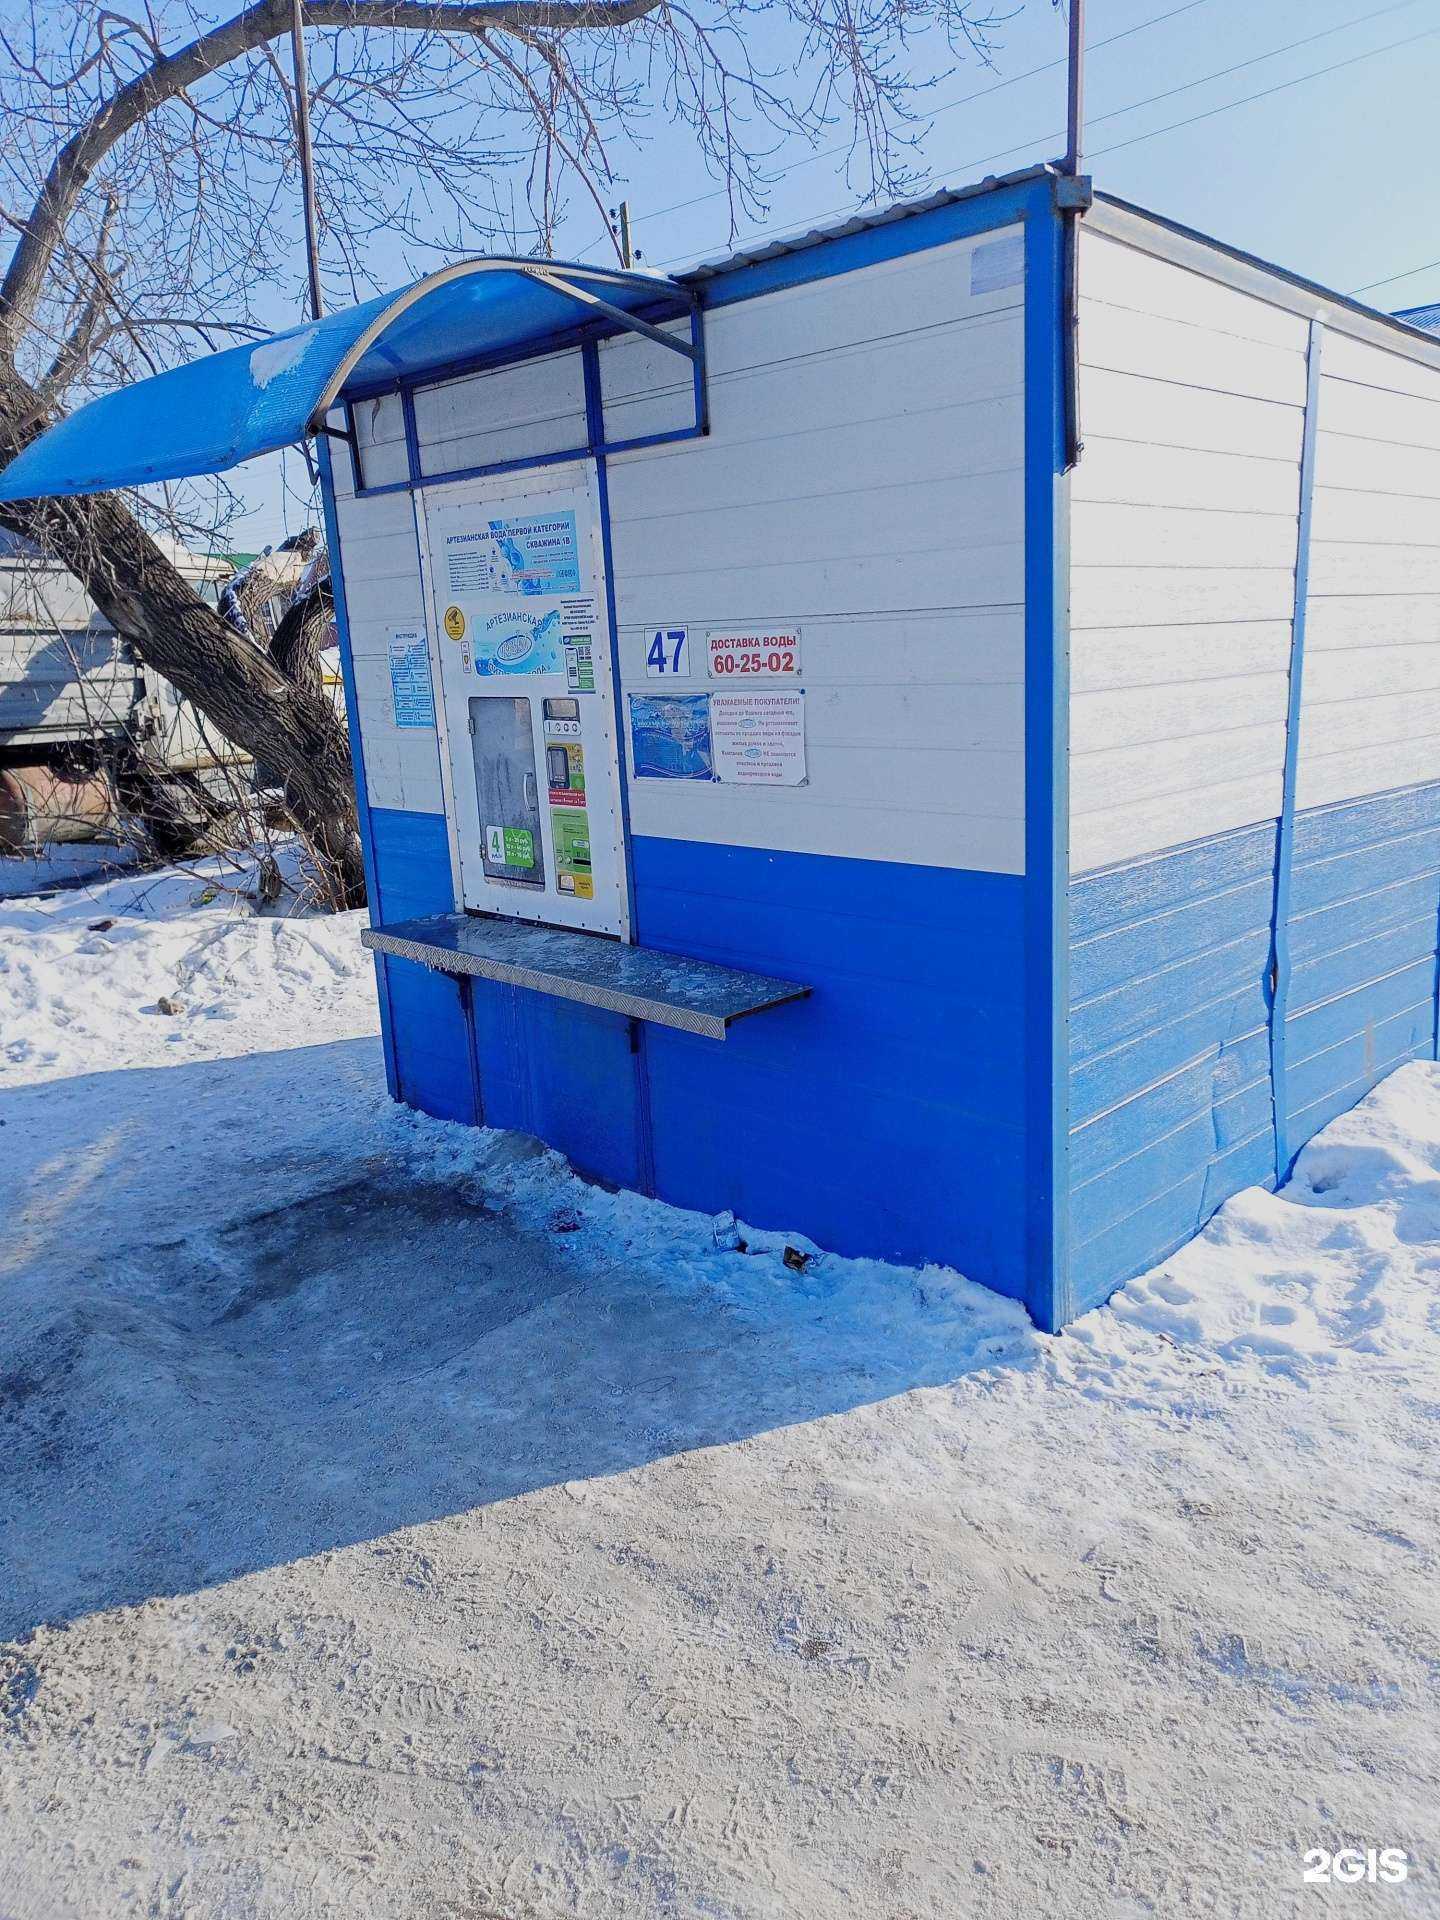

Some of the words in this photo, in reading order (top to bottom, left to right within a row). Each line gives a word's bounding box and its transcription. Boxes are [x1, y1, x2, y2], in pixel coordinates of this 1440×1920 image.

[446, 531, 489, 545] АРТЕЗИАНСКАЯ
[490, 529, 507, 539] ВОДА
[507, 525, 532, 537] ПЕРВОЙ
[533, 522, 570, 535] КАТЕГОРИИ
[526, 538, 560, 550] СКВАЖИНА
[647, 631, 686, 673] 47
[710, 637, 760, 651] ДОСТАВКА
[763, 635, 797, 649] ВОДЫ
[713, 652, 795, 674] 60-25-02
[713, 698, 753, 706] УВАЖАЕМЫЕ
